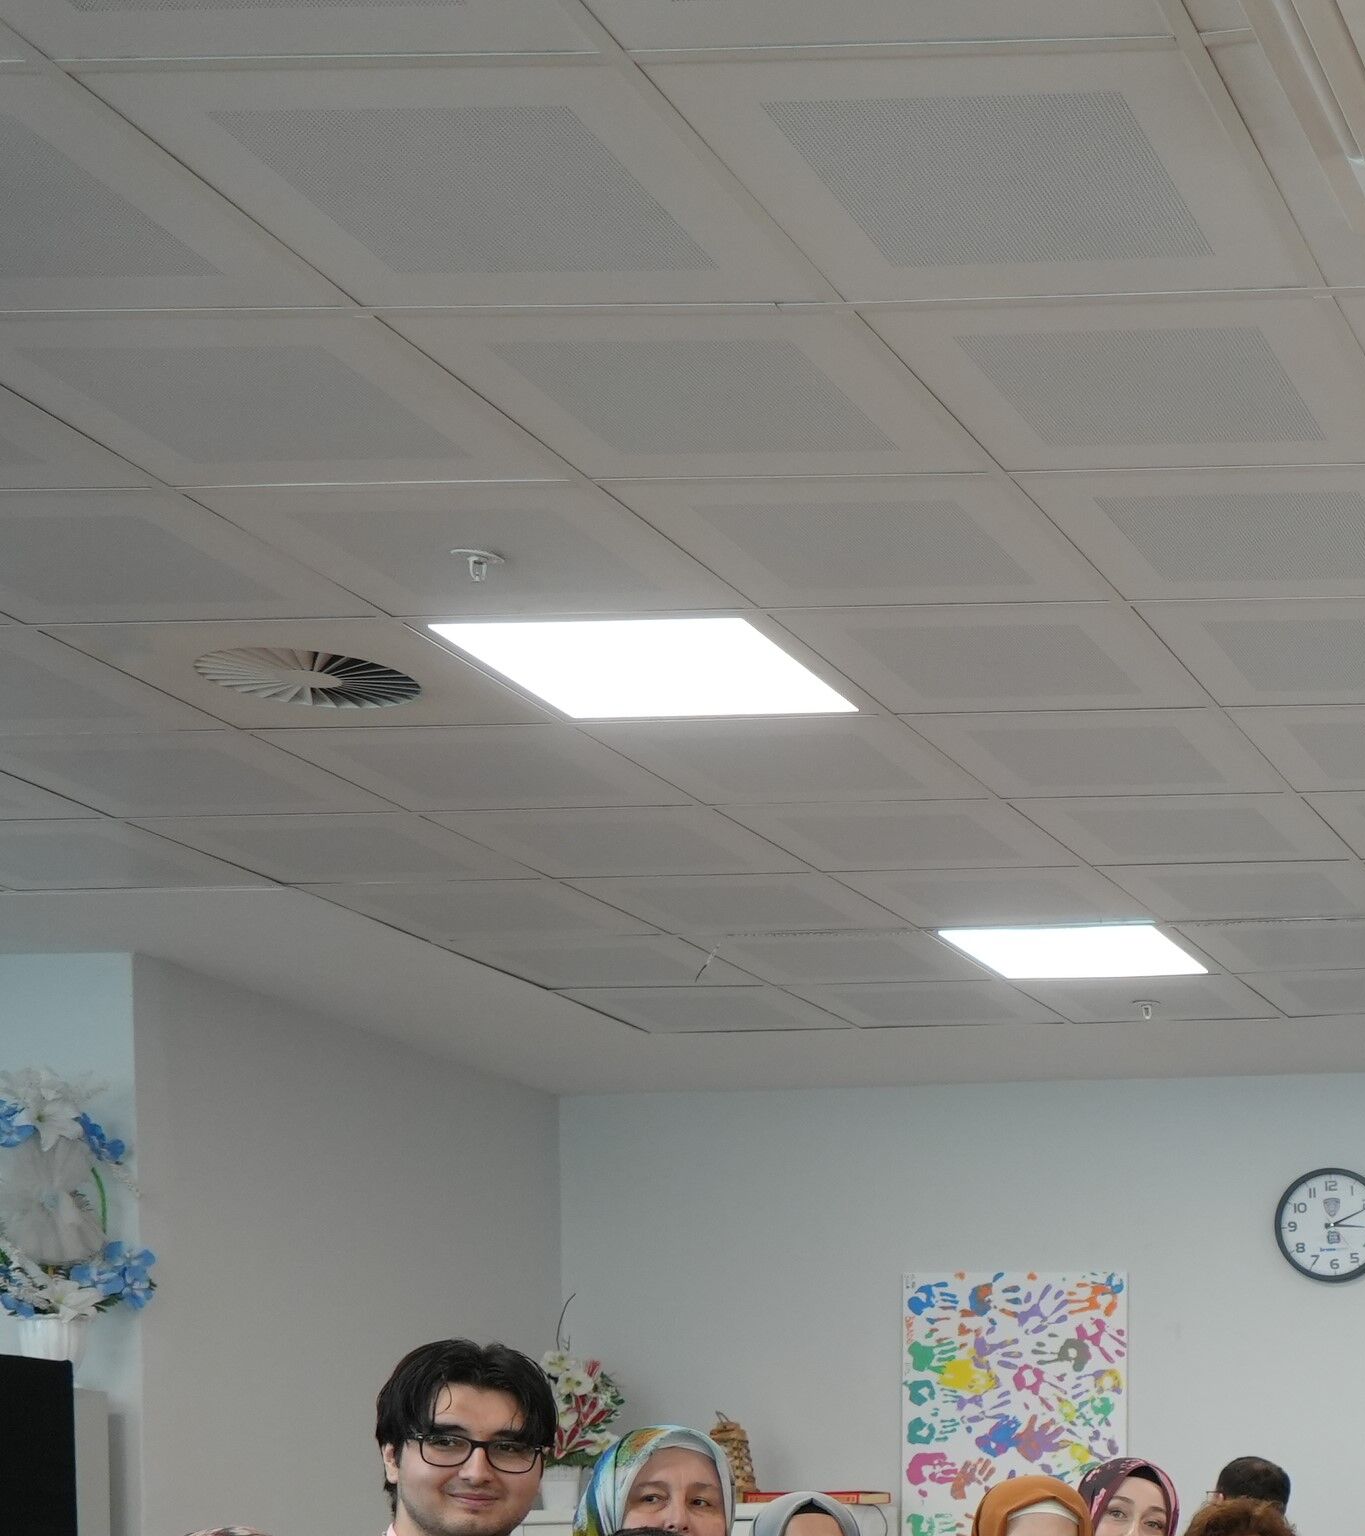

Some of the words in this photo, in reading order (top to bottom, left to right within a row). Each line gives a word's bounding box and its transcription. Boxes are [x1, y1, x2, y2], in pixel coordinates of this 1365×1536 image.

[1324, 1180, 1338, 1192] 12
[1308, 1187, 1317, 1199] 11
[1293, 1202, 1307, 1214] 10
[1287, 1221, 1298, 1232] 9
[1295, 1242, 1306, 1253] 8
[1311, 1254, 1320, 1267] 7
[1329, 1258, 1340, 1270] 6
[1349, 1252, 1360, 1264] 5
